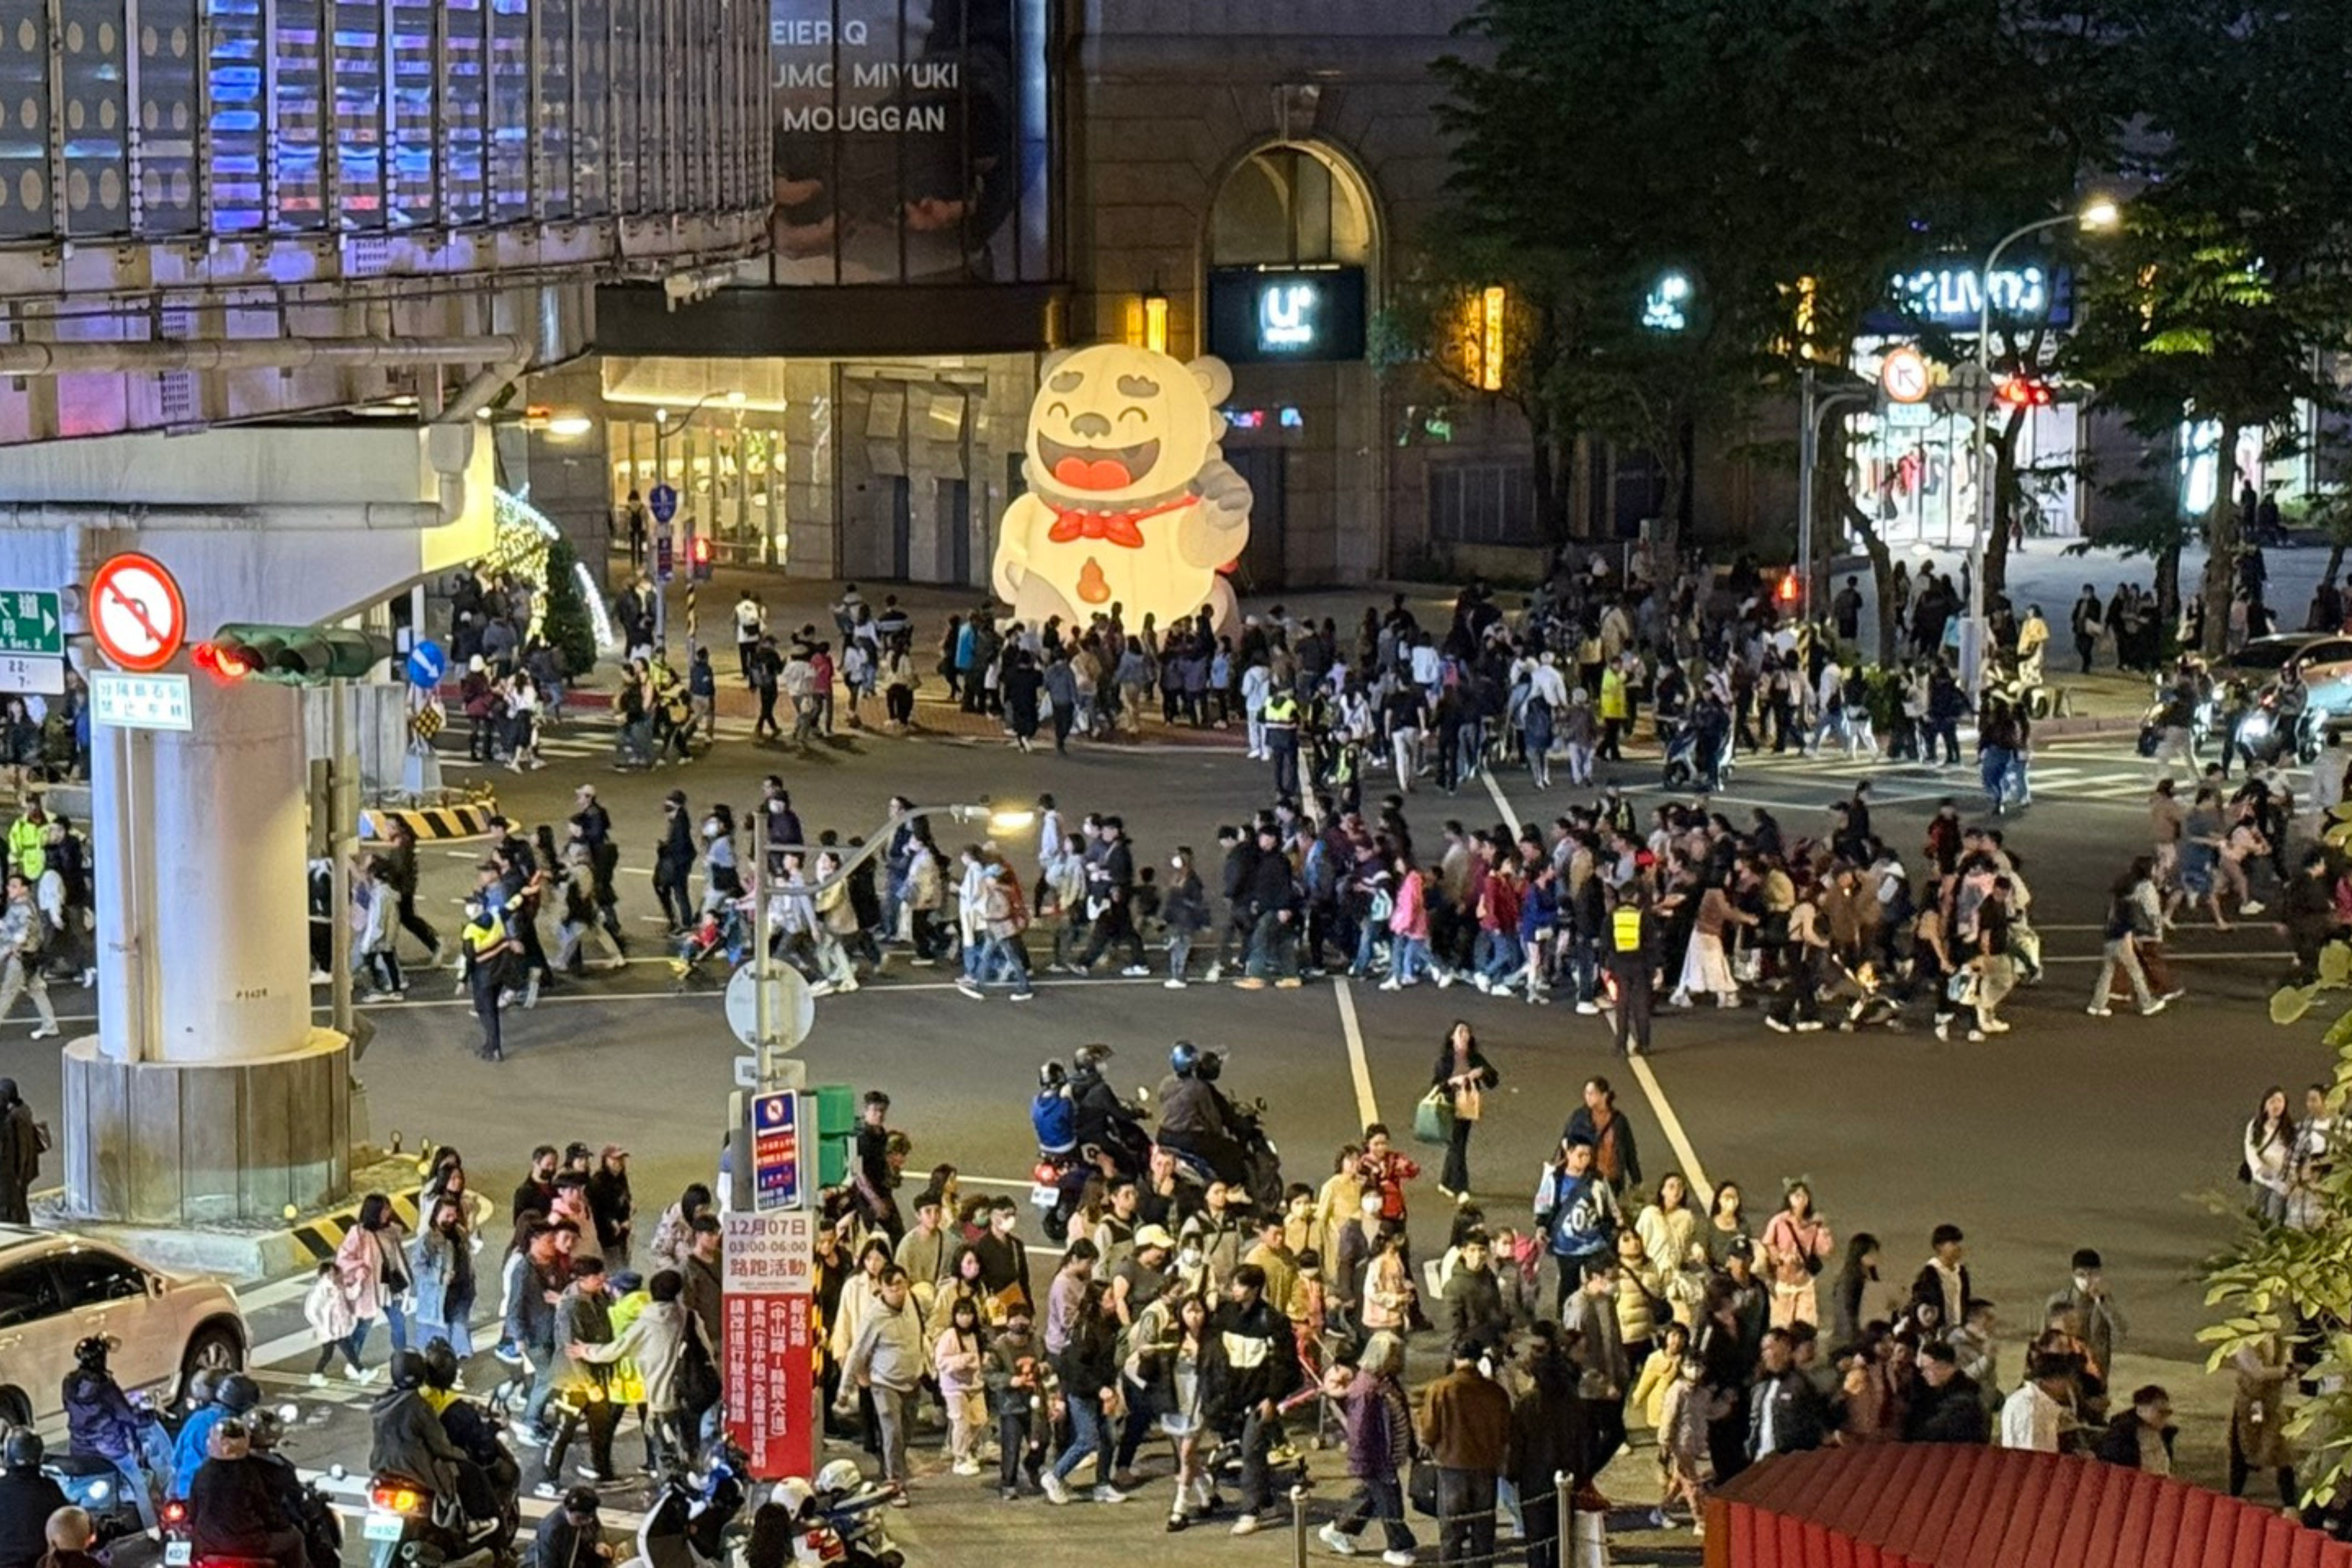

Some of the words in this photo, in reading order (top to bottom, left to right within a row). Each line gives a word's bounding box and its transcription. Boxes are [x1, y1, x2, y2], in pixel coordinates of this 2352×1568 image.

[853, 63, 958, 88] MIYUKI
[783, 106, 945, 131] MOUGGAN
[34, 636, 42, 650] 2
[729, 1218, 806, 1235] 12月07日
[729, 1241, 807, 1253] 03:00-06:00
[730, 1258, 806, 1277] 路跑活動
